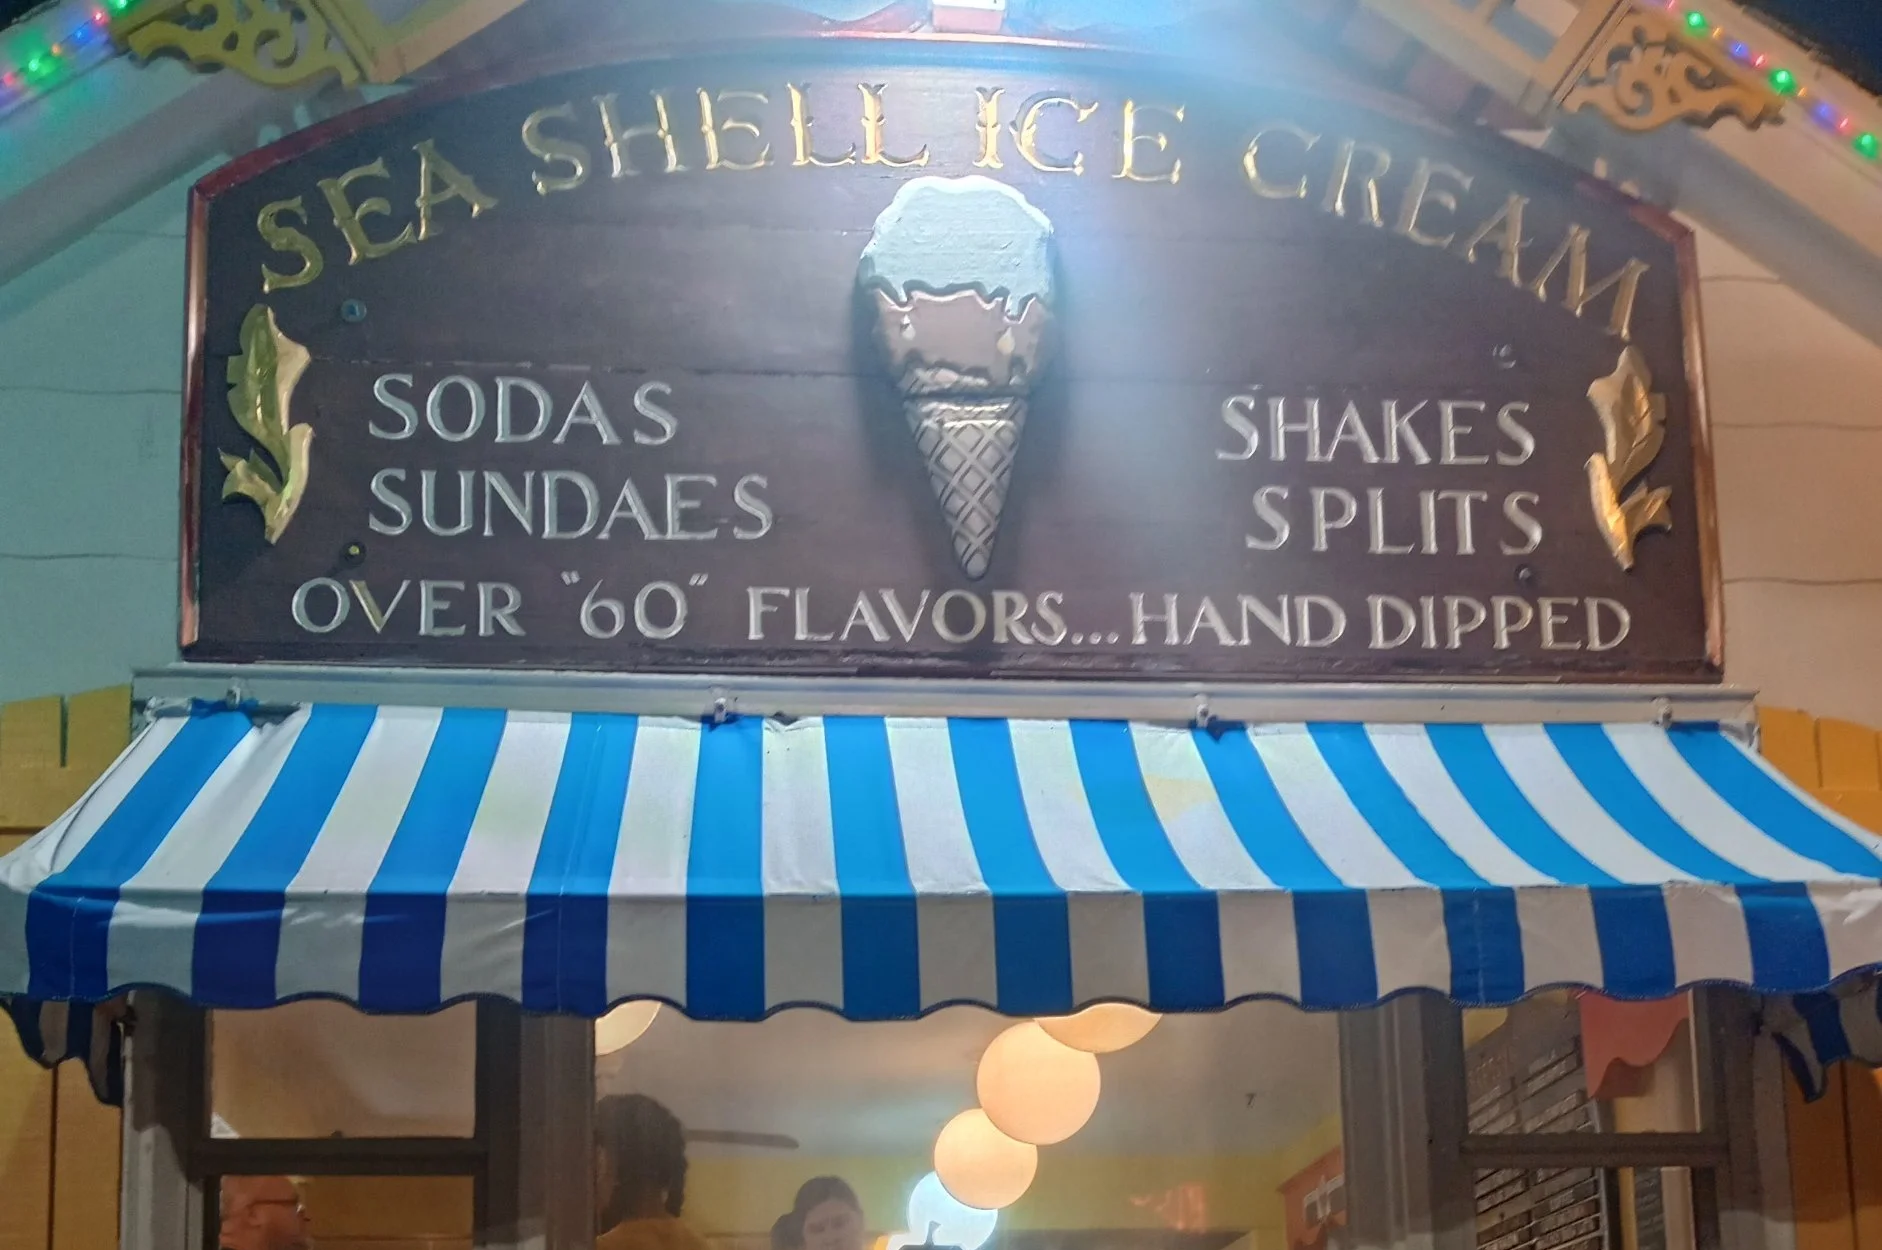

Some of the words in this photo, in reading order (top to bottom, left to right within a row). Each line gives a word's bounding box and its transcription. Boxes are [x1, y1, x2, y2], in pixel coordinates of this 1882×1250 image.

[256, 139, 498, 293] SEA
[521, 81, 930, 196] SHELL
[974, 86, 1188, 184] ICE
[1243, 127, 1650, 339] CREAM
[368, 374, 679, 445] SODAS
[1216, 396, 1536, 465] SHAKES
[367, 468, 774, 541] SUNDAES
[1246, 486, 1544, 556] SPLITS
[290, 577, 526, 637] OVER
[1130, 592, 1348, 650] HAND
[1368, 594, 1634, 653] DIPPED
